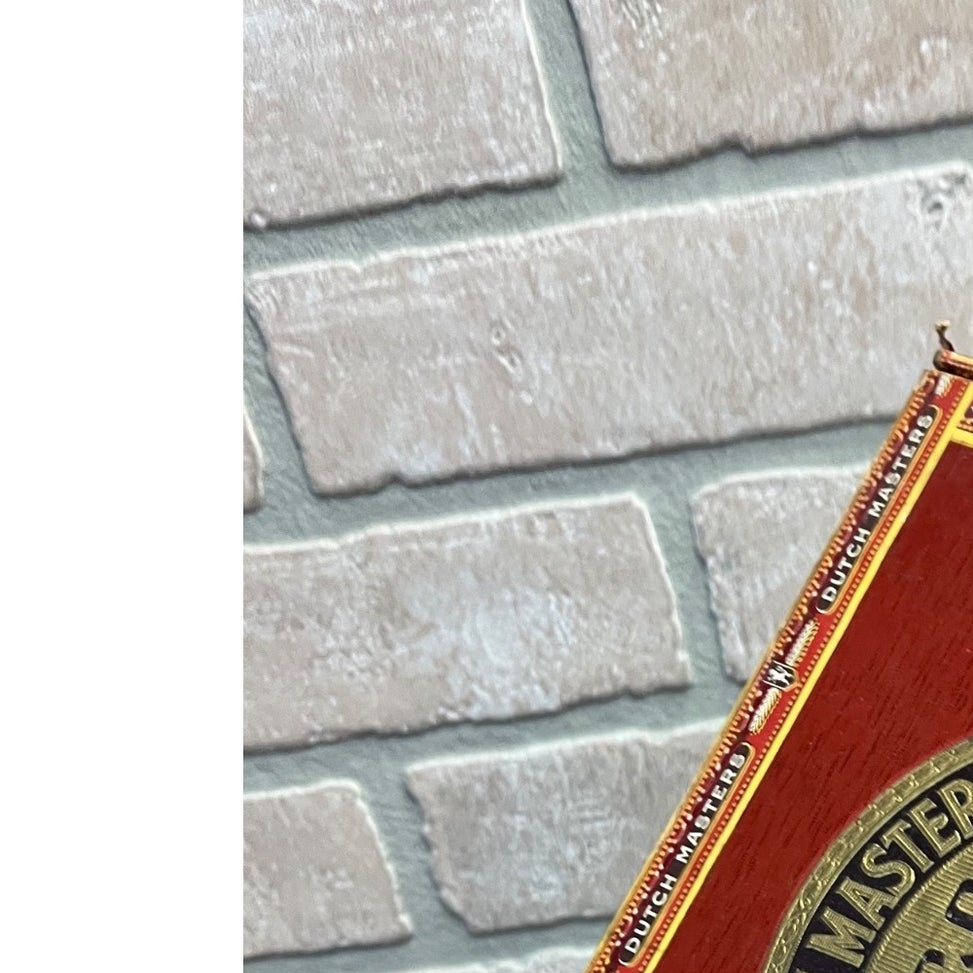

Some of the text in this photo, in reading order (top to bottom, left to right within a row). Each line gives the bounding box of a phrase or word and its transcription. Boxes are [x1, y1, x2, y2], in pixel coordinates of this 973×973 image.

[822, 415, 933, 602] DUTCH MASTERS
[624, 753, 745, 954] DUTCH MASTERS
